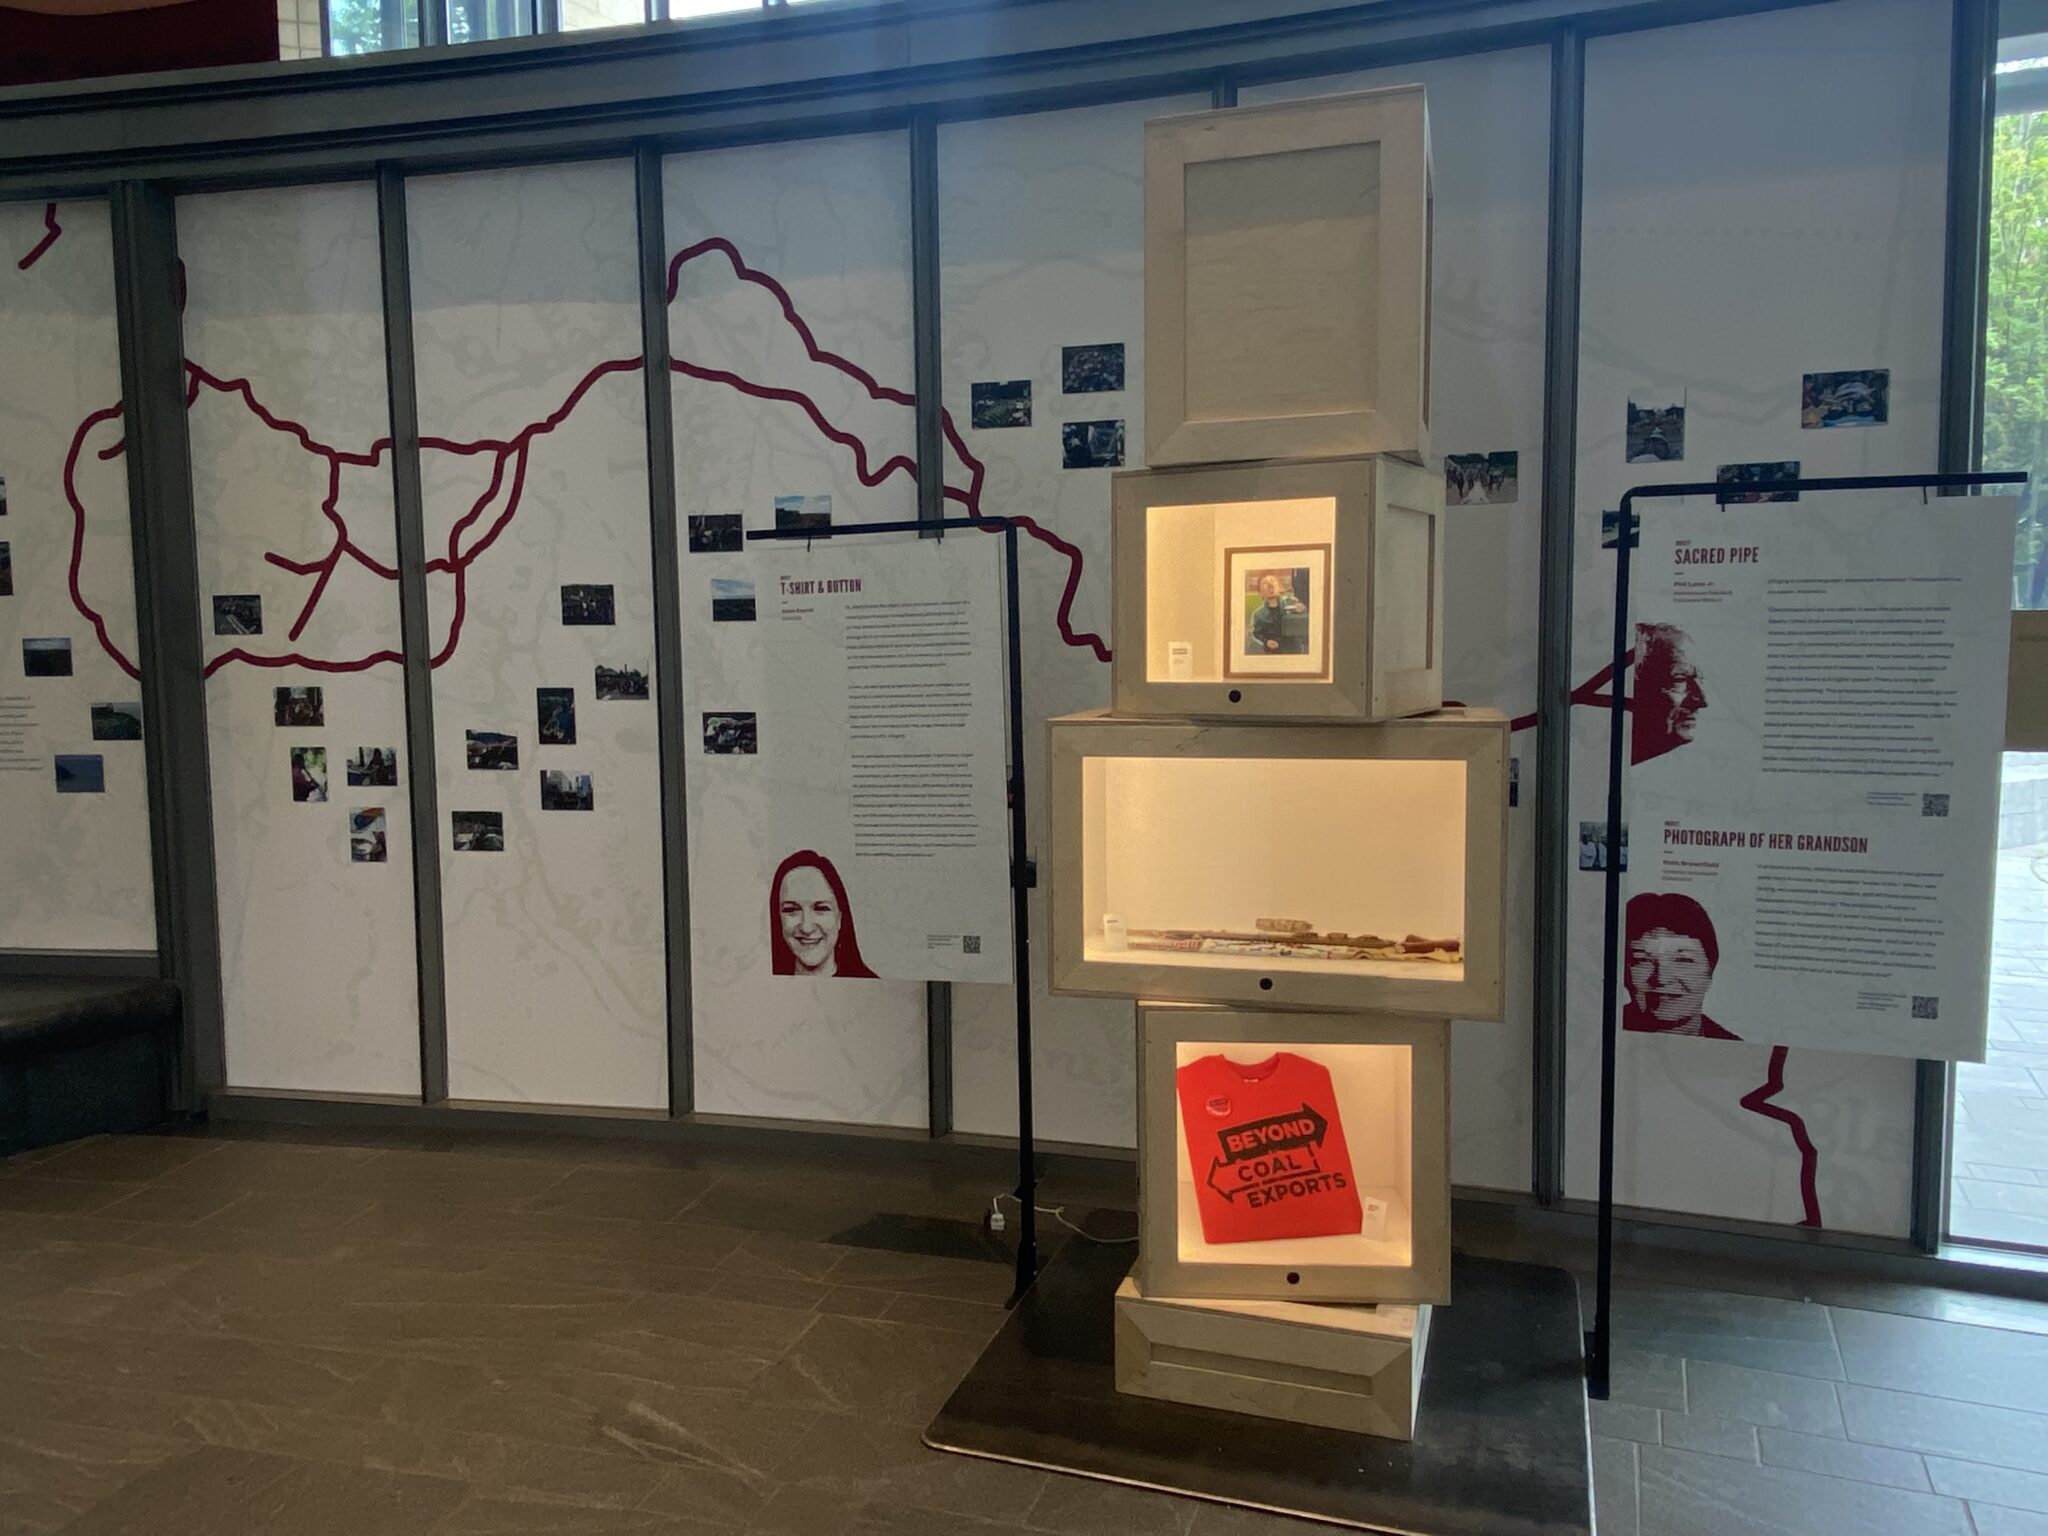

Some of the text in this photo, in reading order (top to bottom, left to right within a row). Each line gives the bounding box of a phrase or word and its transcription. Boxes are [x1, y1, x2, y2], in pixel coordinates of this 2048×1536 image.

[1675, 547, 1760, 564] SACRED PIPE
[781, 579, 861, 595] T-SHIRT & BUTTON
[1664, 829, 1867, 853] PHOTOGRAPH OF HER GRANDSON
[1226, 1119, 1315, 1152] BEYOND
[1238, 1155, 1302, 1182] COAL
[1248, 1173, 1347, 1208] EXPORTS
